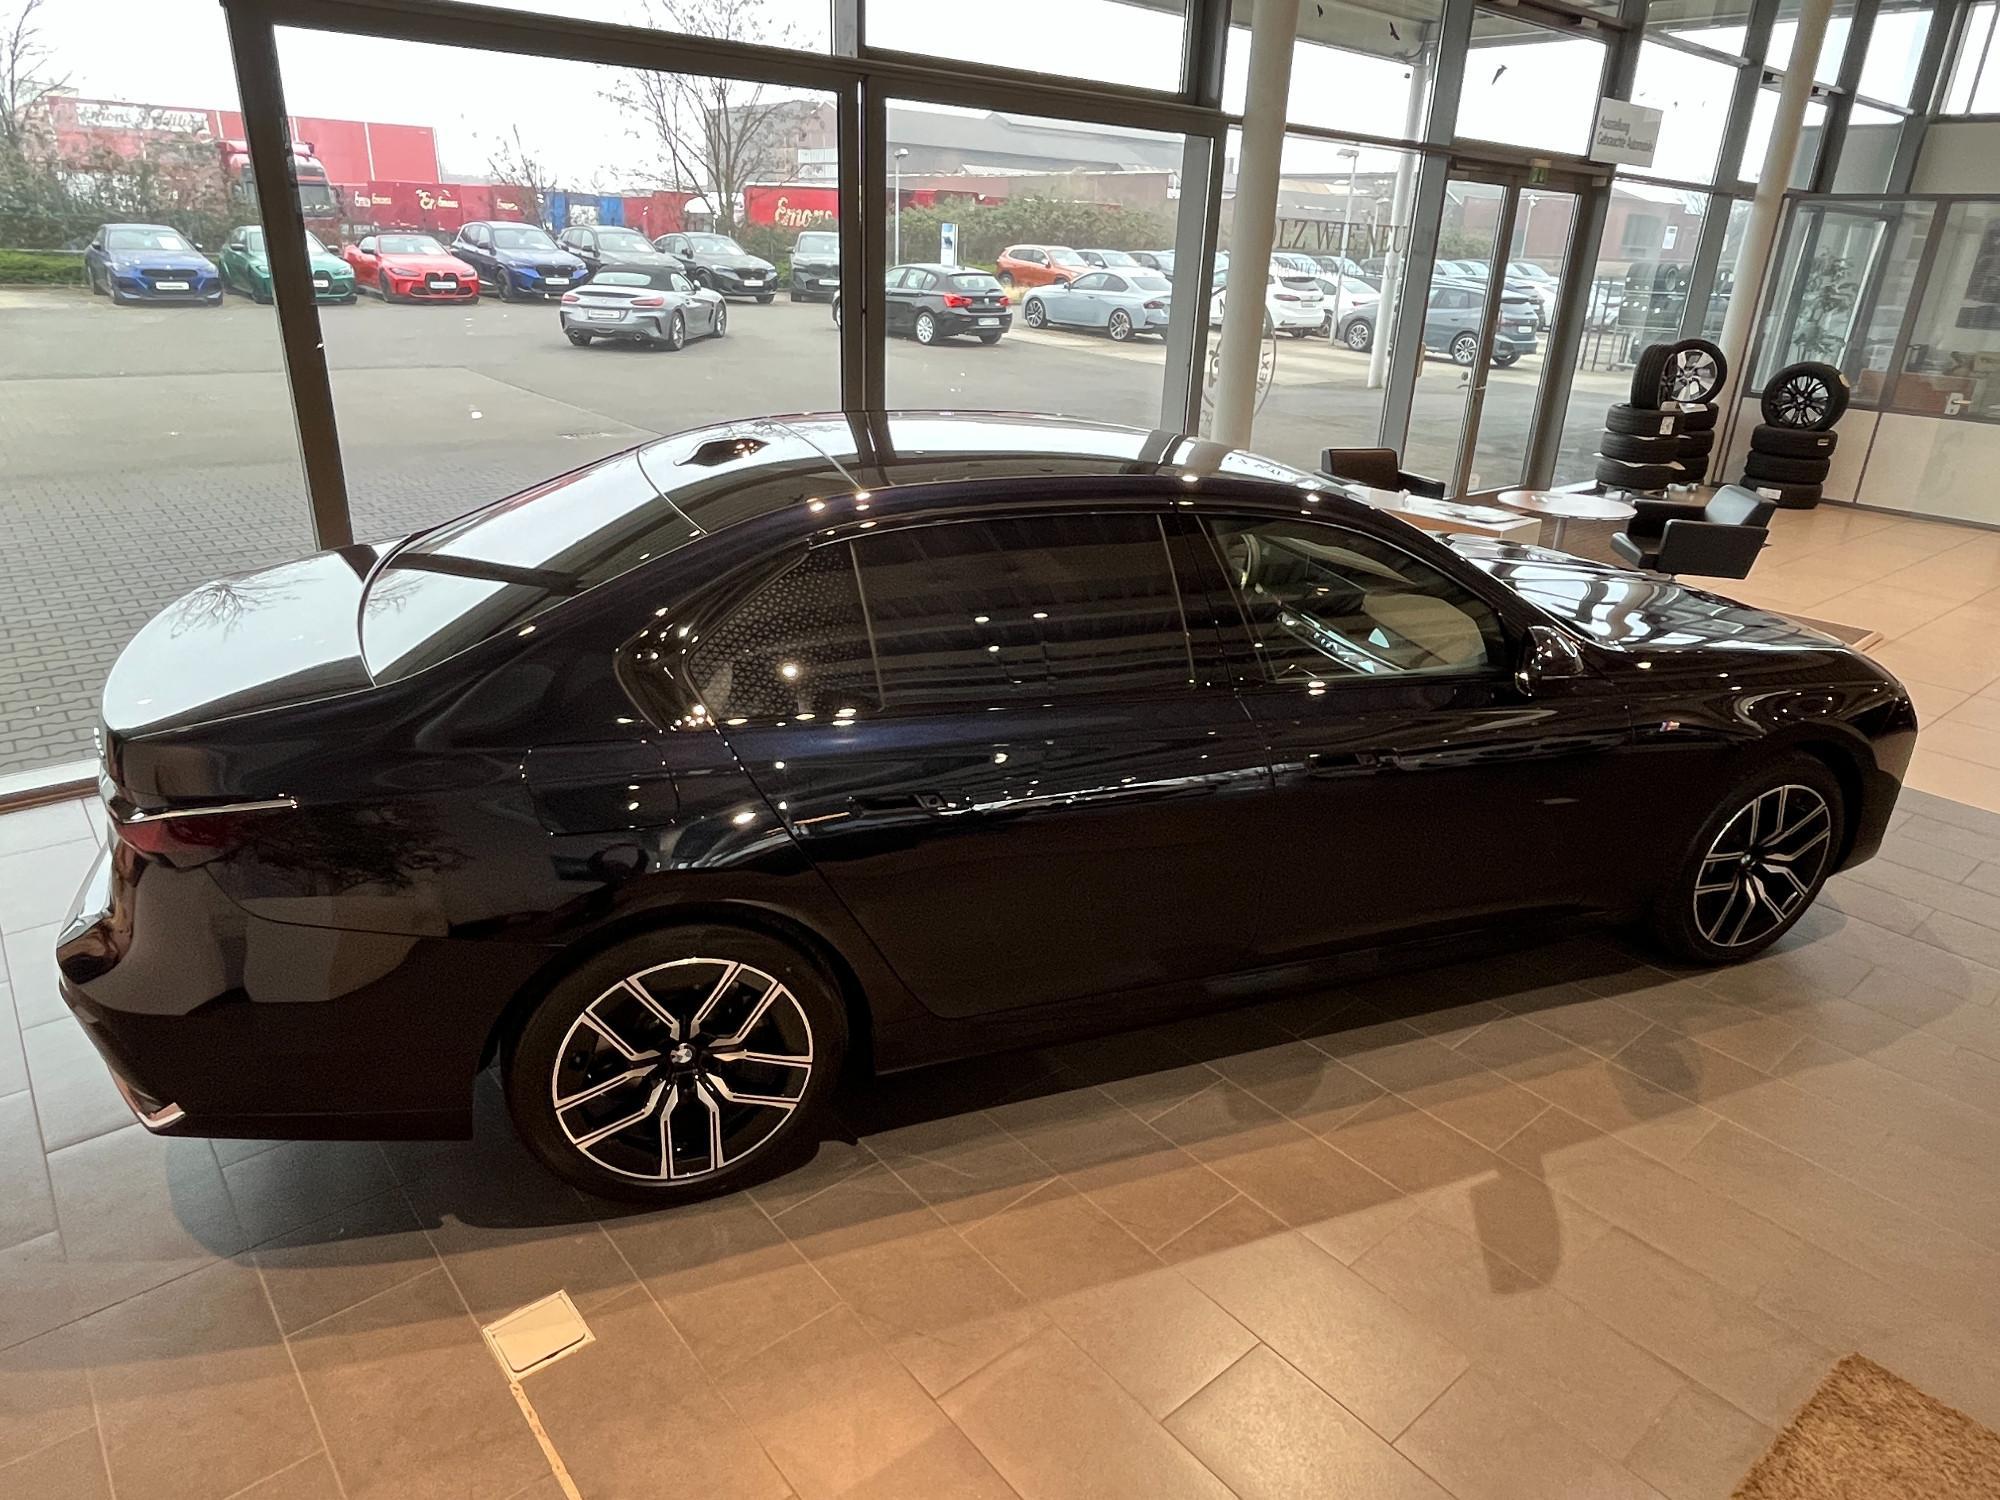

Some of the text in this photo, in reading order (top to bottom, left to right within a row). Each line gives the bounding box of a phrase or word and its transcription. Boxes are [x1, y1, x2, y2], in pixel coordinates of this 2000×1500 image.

[1316, 219, 1363, 251] WIE
[1366, 223, 1408, 254] NEU
[1255, 351, 1272, 394] NEXT
